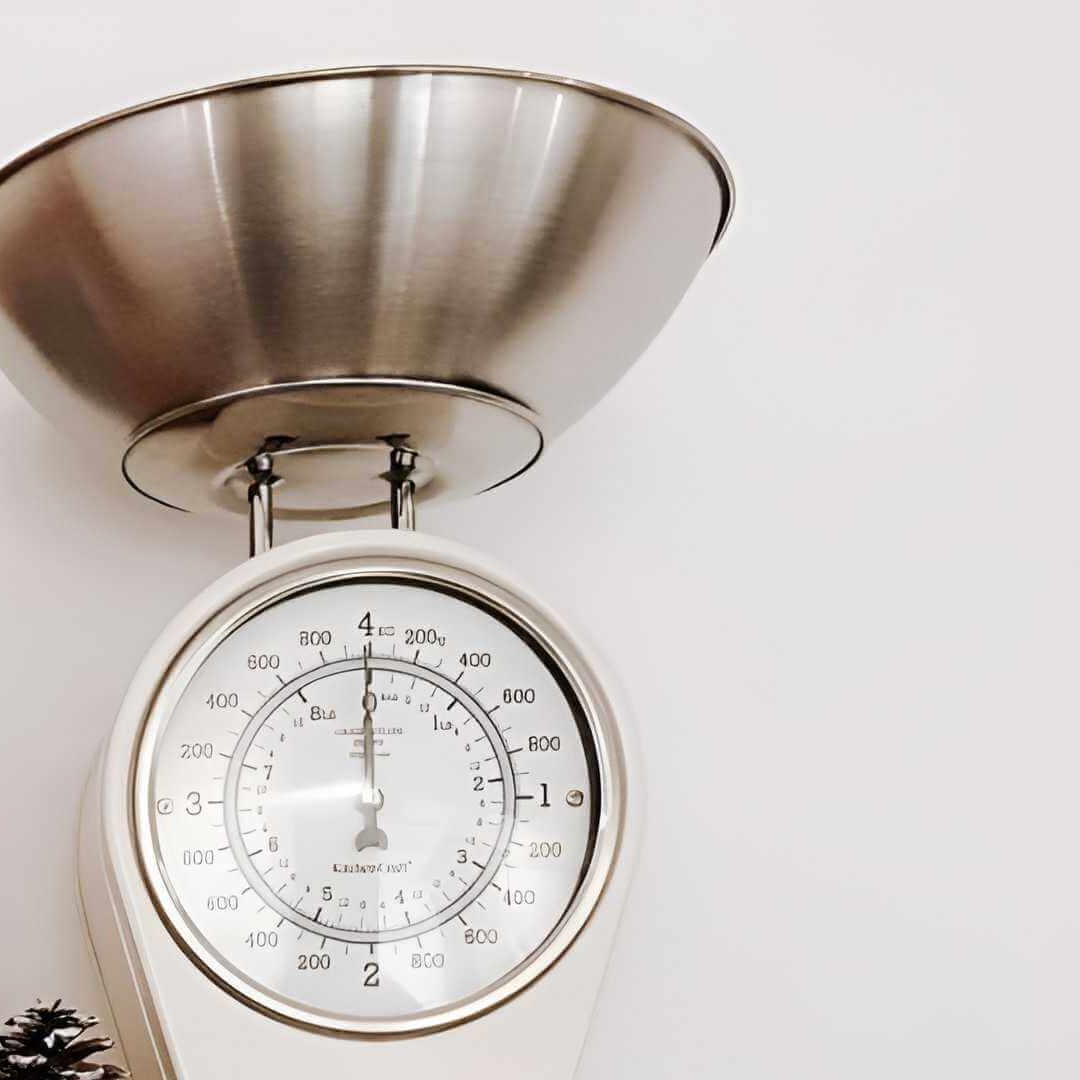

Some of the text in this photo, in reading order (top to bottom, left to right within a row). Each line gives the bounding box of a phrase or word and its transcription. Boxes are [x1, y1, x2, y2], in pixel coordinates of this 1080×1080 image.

[357, 611, 375, 637] 4
[185, 791, 202, 816] 3
[539, 783, 551, 808] 1
[297, 953, 331, 970] 200
[363, 962, 380, 987] 2
